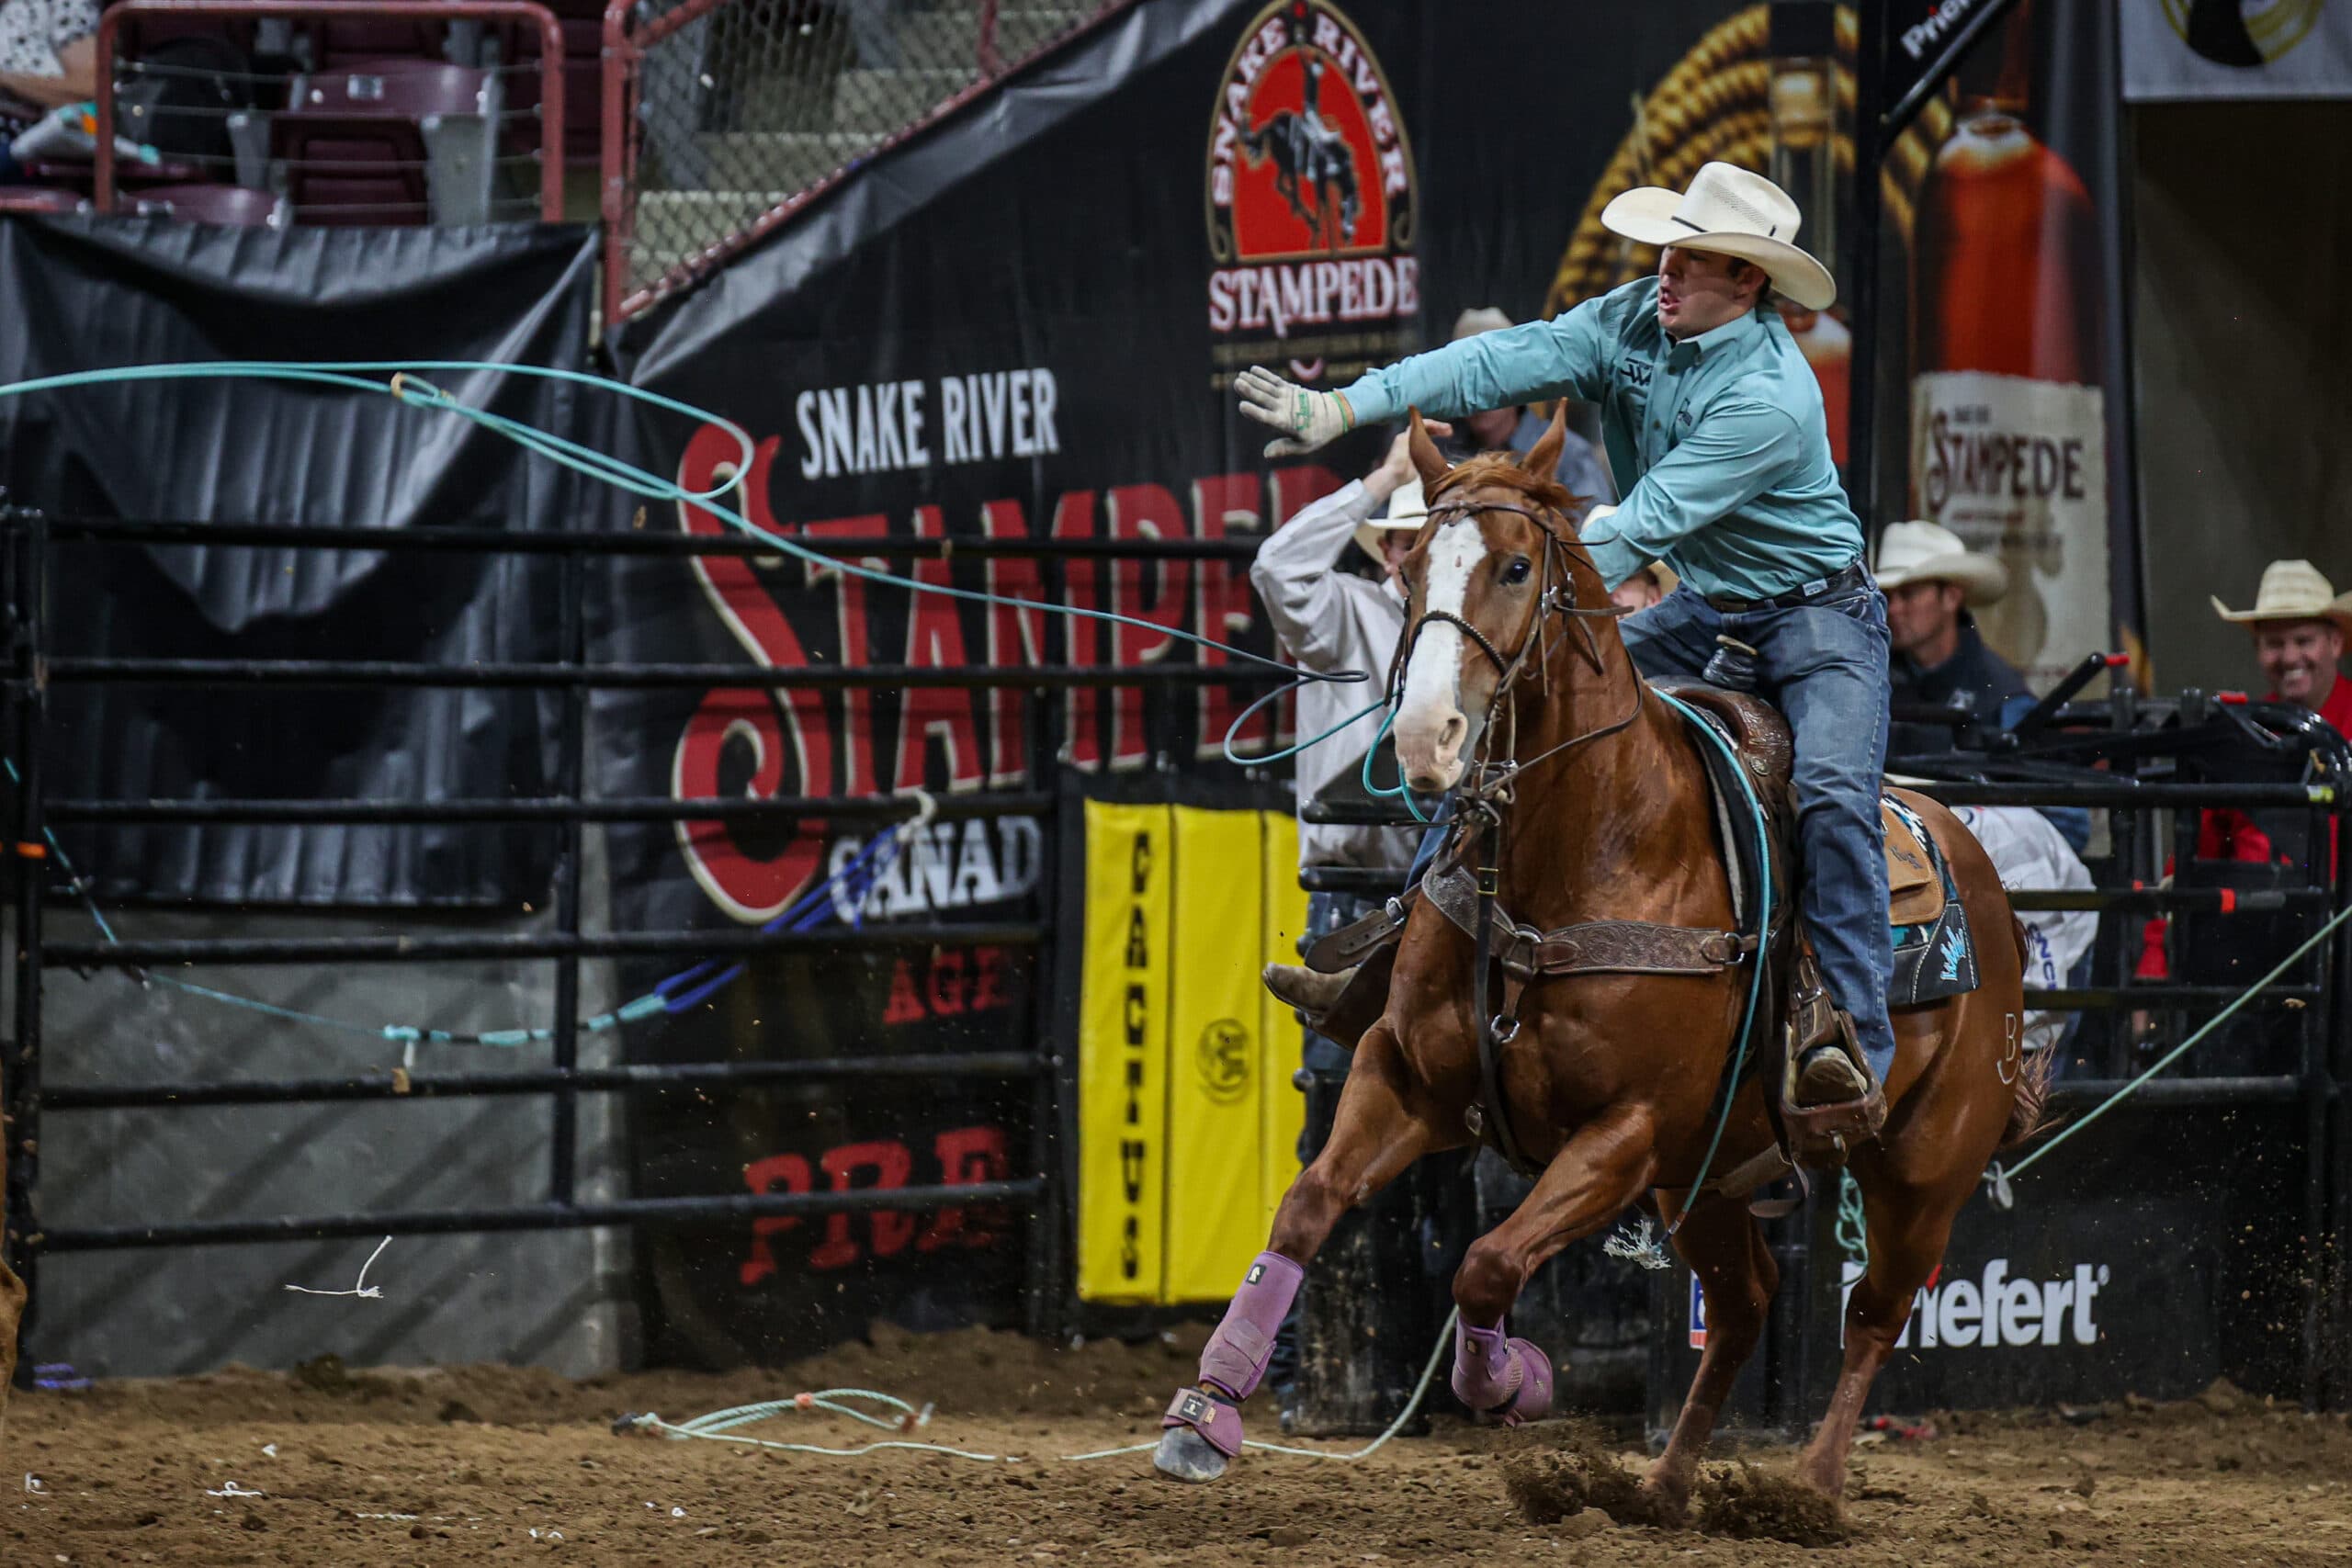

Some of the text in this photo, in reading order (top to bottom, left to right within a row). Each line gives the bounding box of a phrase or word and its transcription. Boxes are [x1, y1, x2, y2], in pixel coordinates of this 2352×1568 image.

[1211, 11, 1407, 206] SNAKE RIVER
[1208, 255, 1419, 337] STAMPEDE
[796, 368, 1060, 480] SNAKE RIVER
